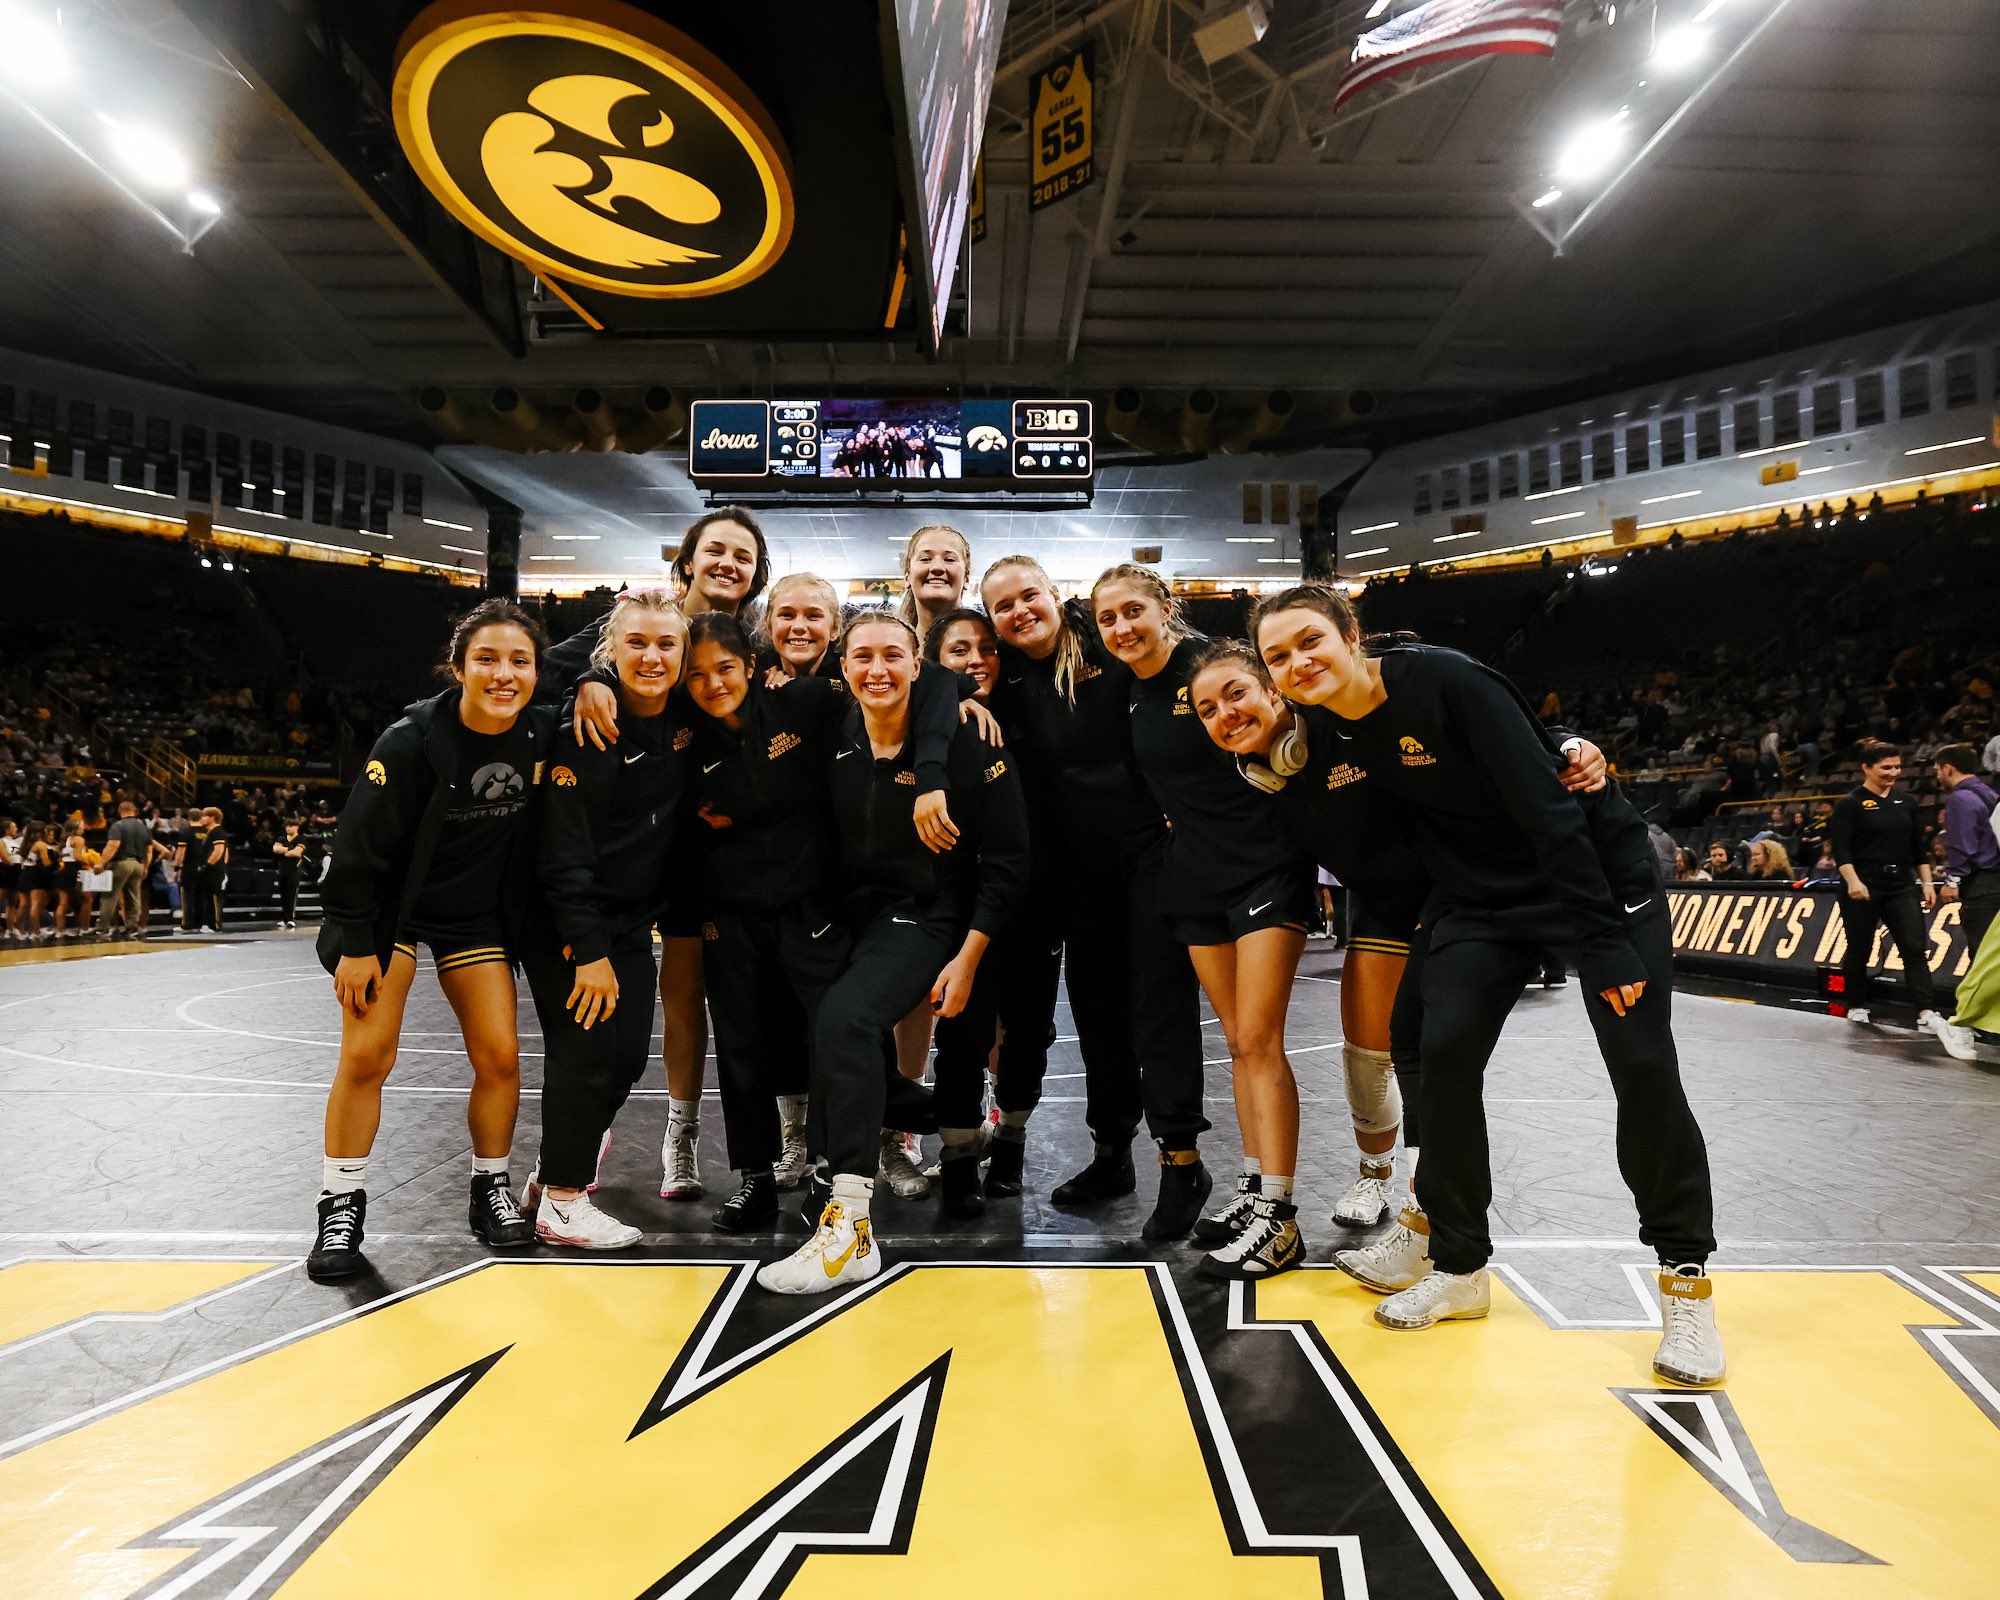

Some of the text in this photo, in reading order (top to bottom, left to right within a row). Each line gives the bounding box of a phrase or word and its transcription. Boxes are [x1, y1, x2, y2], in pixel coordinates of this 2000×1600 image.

[1041, 107, 1085, 166] 55
[1033, 163, 1091, 205] 2018-21
[783, 408, 808, 419] 3:00
[700, 427, 760, 449] Iowa
[803, 426, 811, 437] 0
[803, 444, 811, 455] 0
[1041, 454, 1087, 468] 0 0
[768, 733, 796, 752] WOMEN'S
[771, 732, 787, 745] IOWA
[768, 737, 802, 760] WRESTLING
[1327, 766, 1360, 782] WOMEN'S
[1331, 762, 1350, 775] IOWA
[1327, 770, 1367, 790] WRESTLING
[332, 1195, 352, 1209] NIKE
[1252, 1199, 1277, 1218] NIKE
[1671, 1280, 1696, 1293] NIKE
